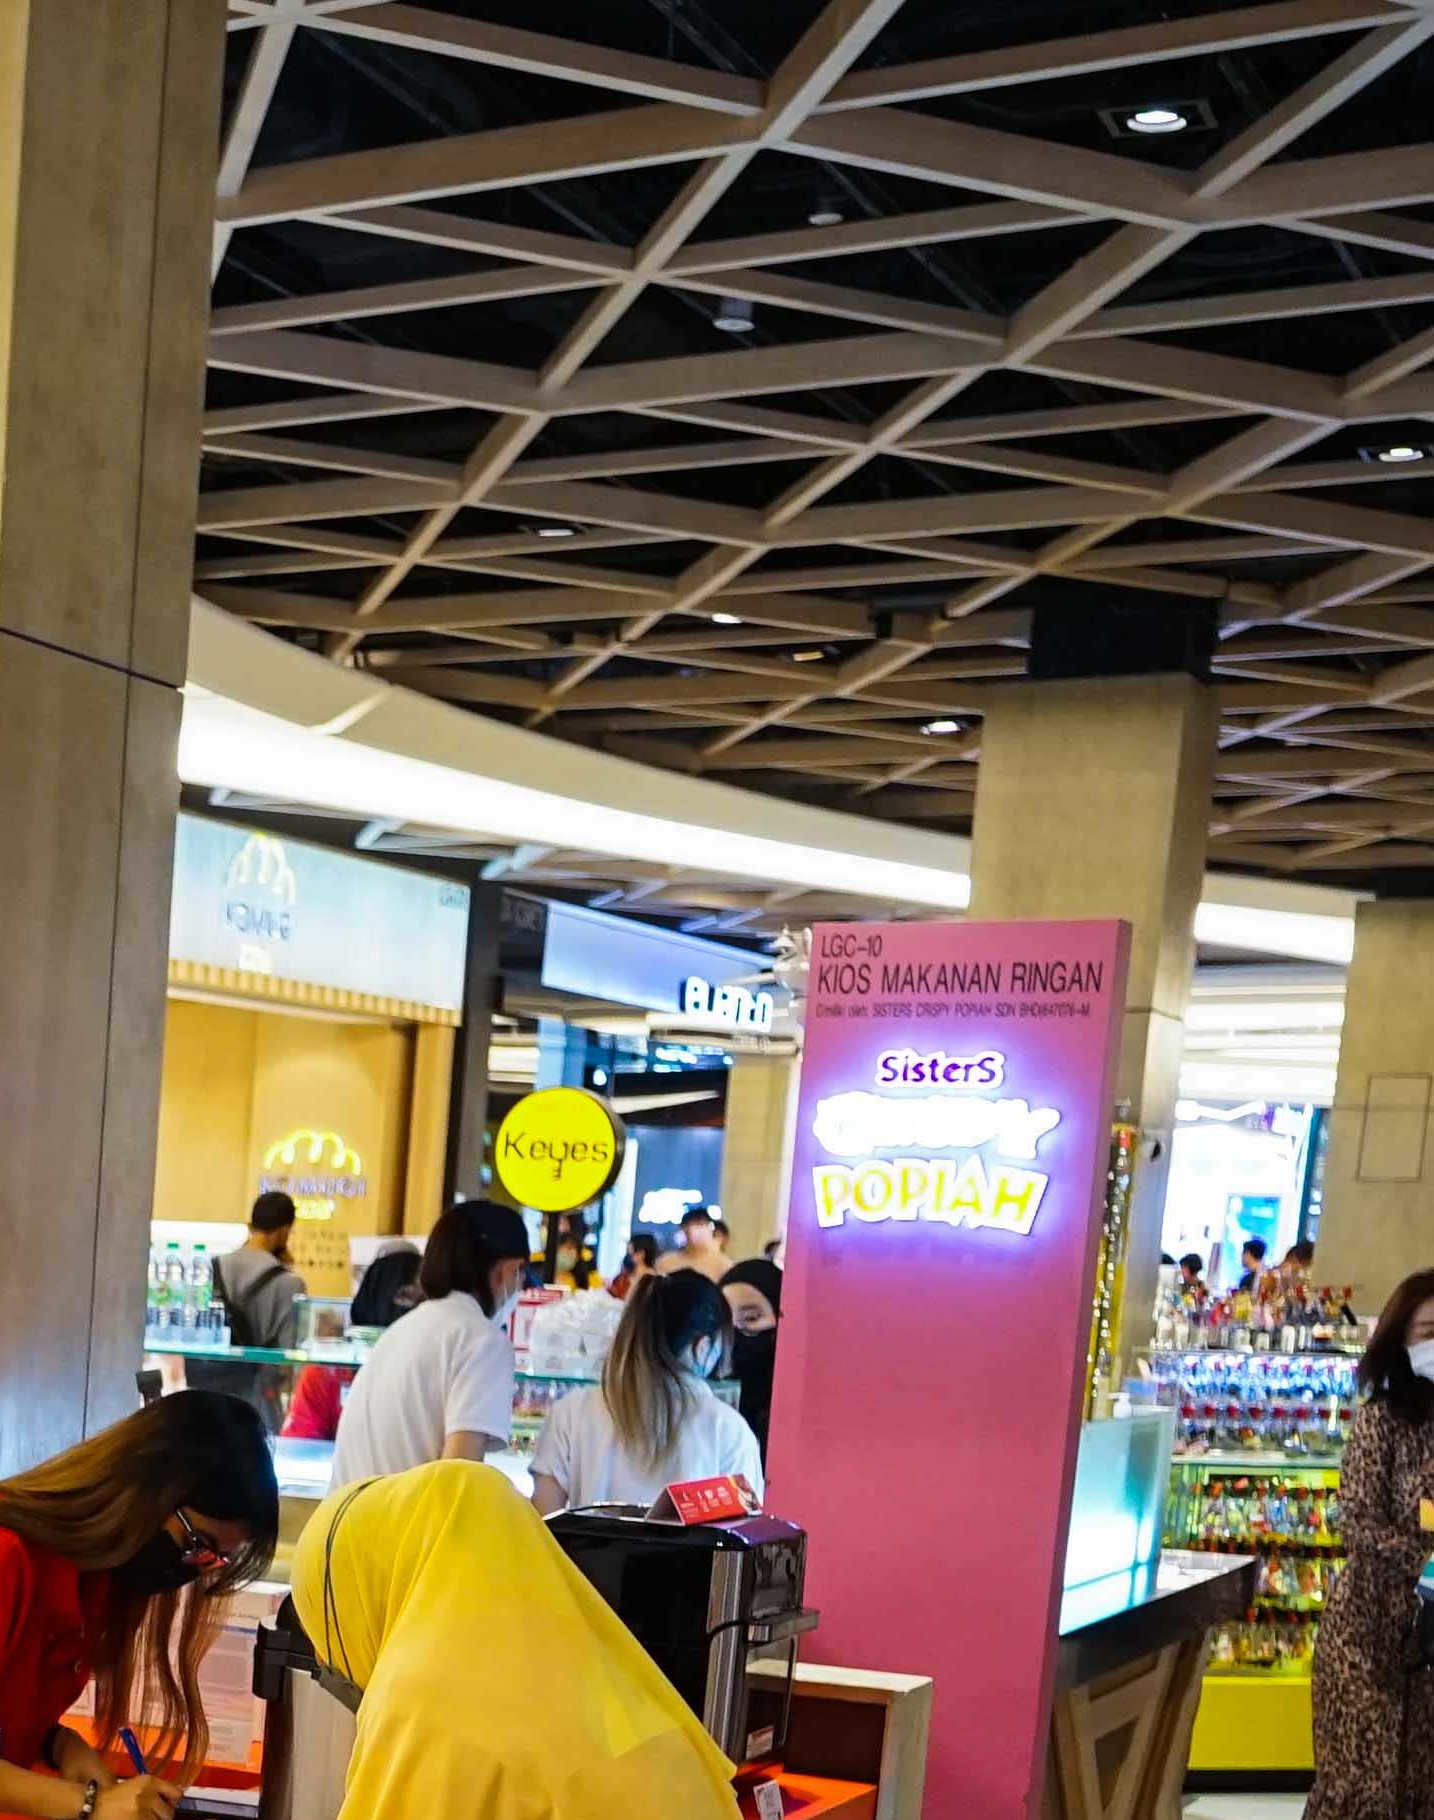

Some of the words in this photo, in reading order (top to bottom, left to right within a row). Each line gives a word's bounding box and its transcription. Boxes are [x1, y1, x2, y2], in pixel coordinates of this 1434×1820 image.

[821, 934, 883, 959] LGC-10
[818, 963, 871, 995] KIOS
[881, 962, 1002, 994] MAKANAN
[1010, 961, 1103, 993] RINGAN
[505, 1132, 609, 1181] Keyes
[820, 1164, 1036, 1224] POPIAH
